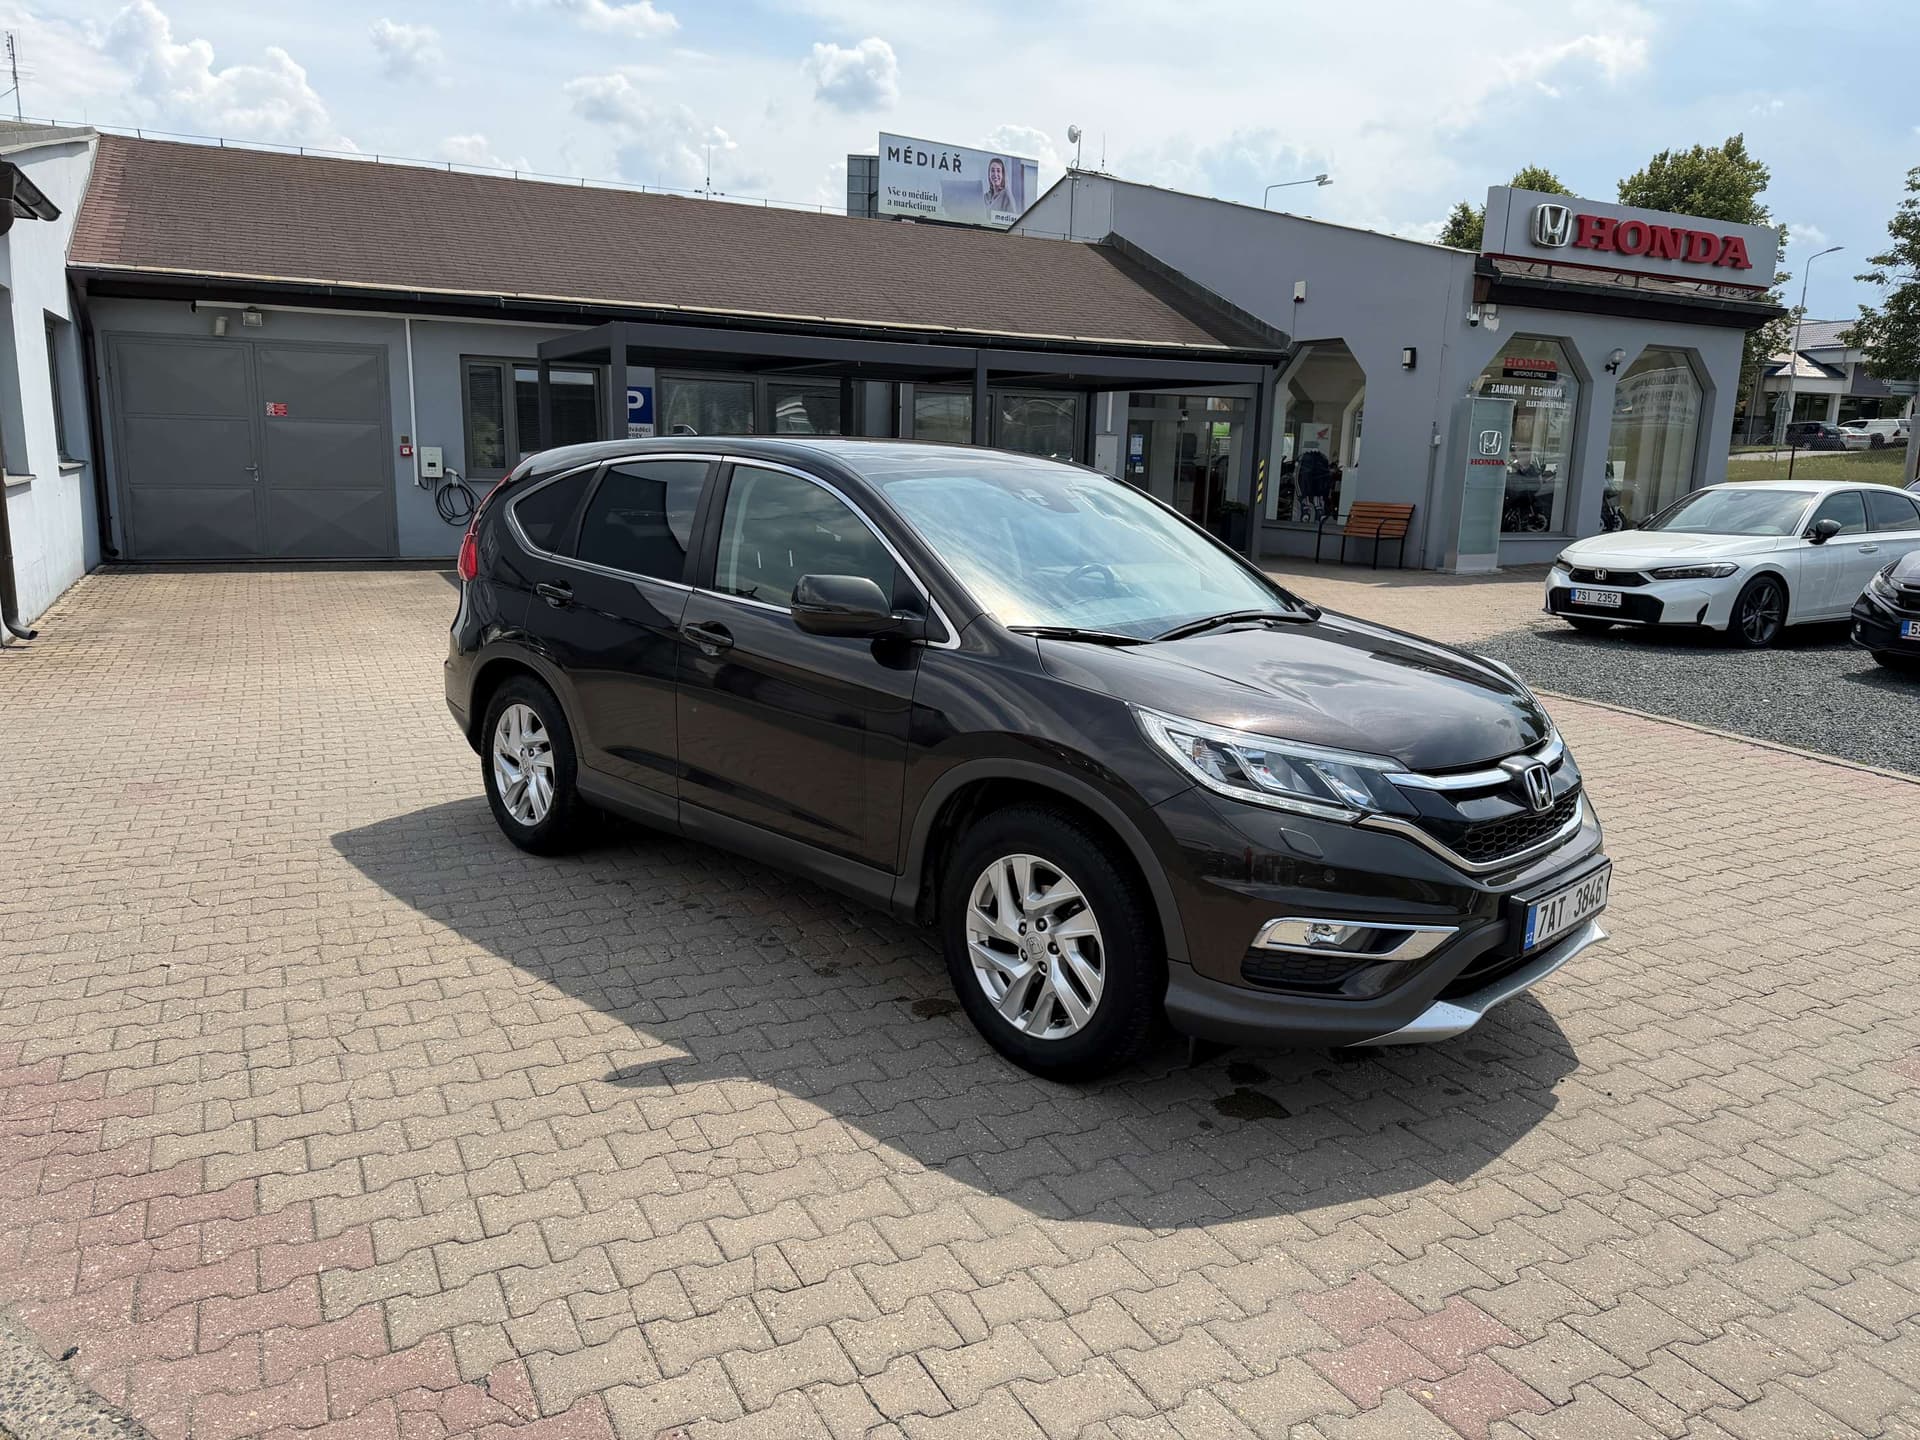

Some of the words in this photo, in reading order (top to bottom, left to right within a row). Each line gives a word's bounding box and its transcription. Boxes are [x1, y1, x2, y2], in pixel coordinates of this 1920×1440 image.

[888, 146, 963, 173] MÉDIÁŘ
[887, 186, 901, 197] Vše
[908, 190, 938, 203] médiích
[893, 200, 936, 213] marketingu
[1574, 214, 1753, 269] HONDA
[1504, 357, 1558, 370] HONDA
[1491, 384, 1526, 396] ZAHRADNÍ
[1530, 386, 1563, 398] TECHNIKA
[627, 391, 644, 419] P
[1470, 458, 1505, 466] HONDA
[1597, 592, 1618, 604] 2352
[1538, 896, 1567, 938] 7AT
[1573, 876, 1605, 918] 3846
